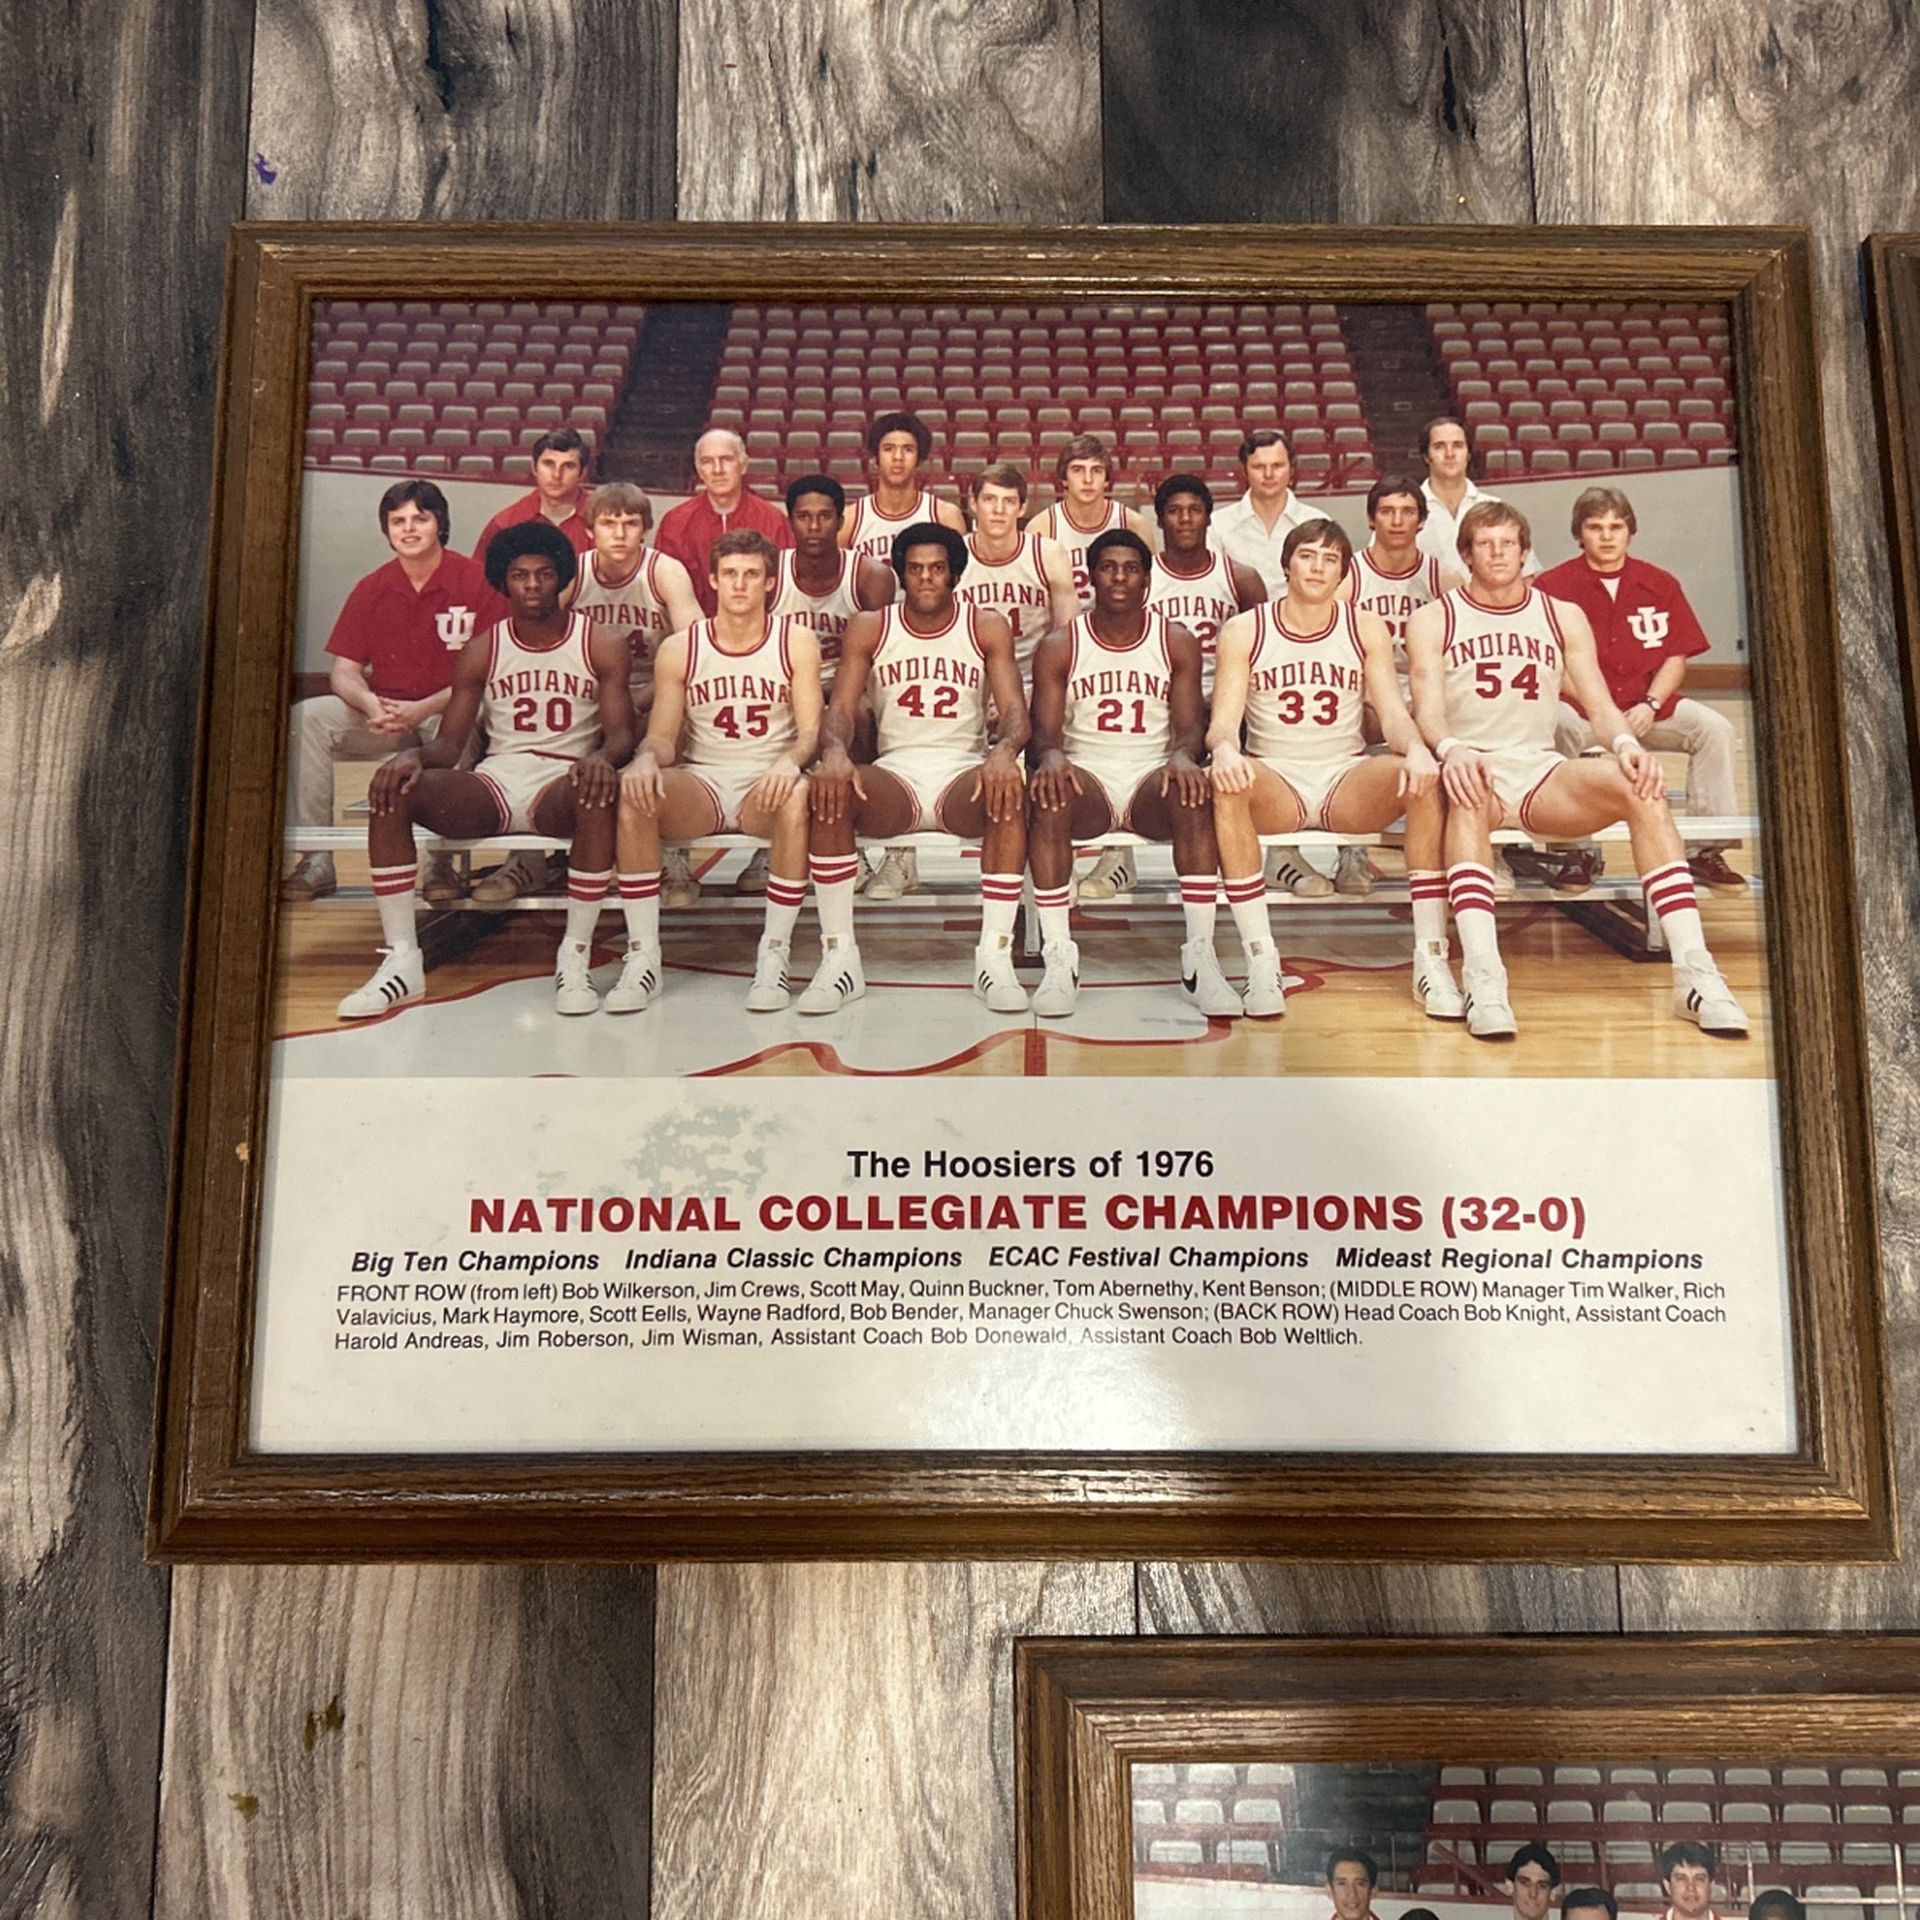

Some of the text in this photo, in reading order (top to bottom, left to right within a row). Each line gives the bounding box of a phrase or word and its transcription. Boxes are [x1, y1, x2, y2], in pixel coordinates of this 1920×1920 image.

[1451, 633, 1556, 670] INDIANA
[488, 669, 594, 701] INDIANA
[878, 656, 980, 690] INDIANA
[1072, 670, 1171, 702] INDIANA
[1253, 661, 1363, 692] INDIANA
[1476, 662, 1539, 700] 54
[688, 675, 789, 707] INDIANA
[897, 685, 959, 719] 42
[1278, 690, 1339, 725] 33
[513, 697, 572, 732] 20
[713, 704, 771, 739] 45
[1098, 699, 1147, 733] 21
[847, 1150, 1214, 1178] The Hoosiers of 1976
[470, 1194, 1586, 1240] NATIONAL COLLEGIATE CHAMPIONS (32-0)
[351, 1246, 1704, 1277] Big Ten Champions Indiana Classic Champions ECAC Festival Champions Mideast Regional Champions
[337, 1279, 1725, 1304] FRONT ROW (from left) Bob Wilkerson, Jim Crews, Scott May, Quinn Buckner, Tom Abernethy, Kent Benson; (MIDDLE ROW) Manager Tim Walker, Rich
[336, 1302, 1726, 1327] Valavicius, Mark Haymore, Scott Eells, Wayne Radford, Bob Bender, Manager Chuck Swenson; (BACK ROW) Head Coach Bob Knight, Assistant Coach
[335, 1326, 1363, 1351] Harold Andreas, Jim Roberson, Jim Wisman, Assistant Coach Bob Donewald, Assistant Coach Bob Weltlich.
